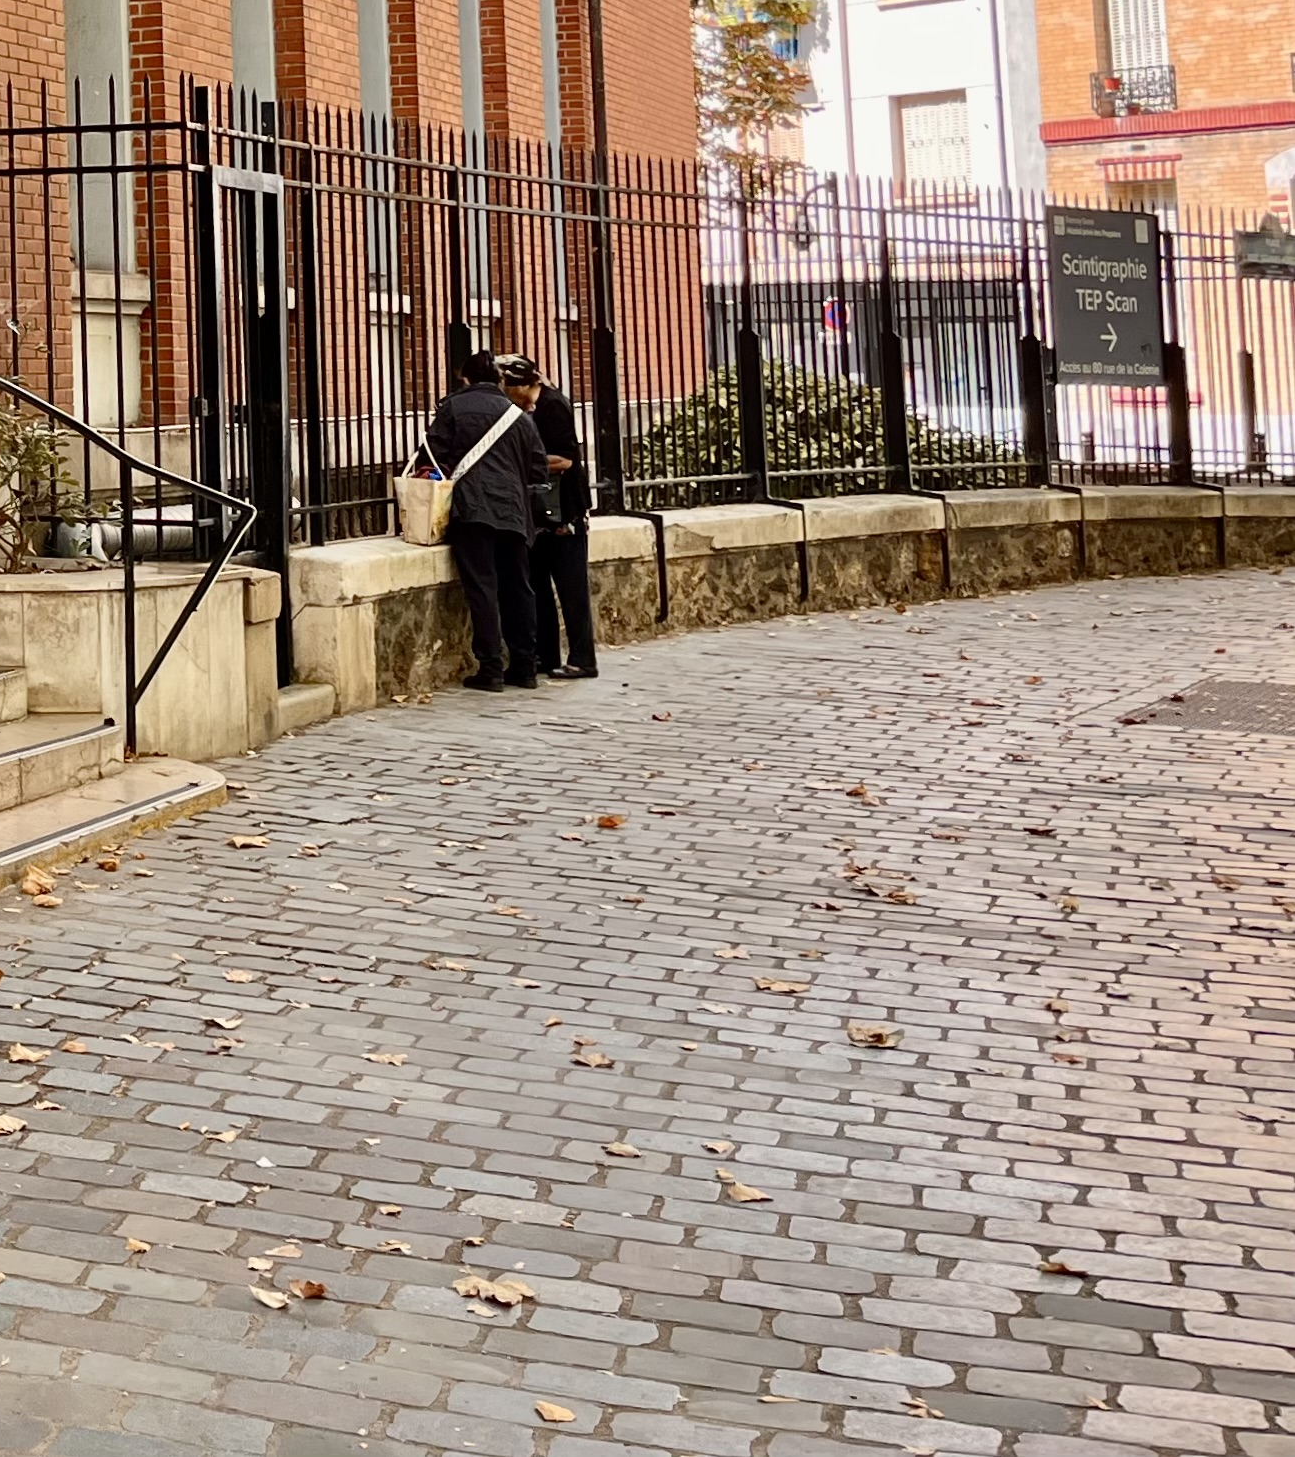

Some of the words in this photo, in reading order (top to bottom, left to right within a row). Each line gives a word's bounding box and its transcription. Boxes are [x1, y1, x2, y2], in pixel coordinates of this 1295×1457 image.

[1061, 252, 1148, 283] Scintigraphie
[1075, 287, 1102, 312] TEP
[1105, 289, 1138, 314] Scan
